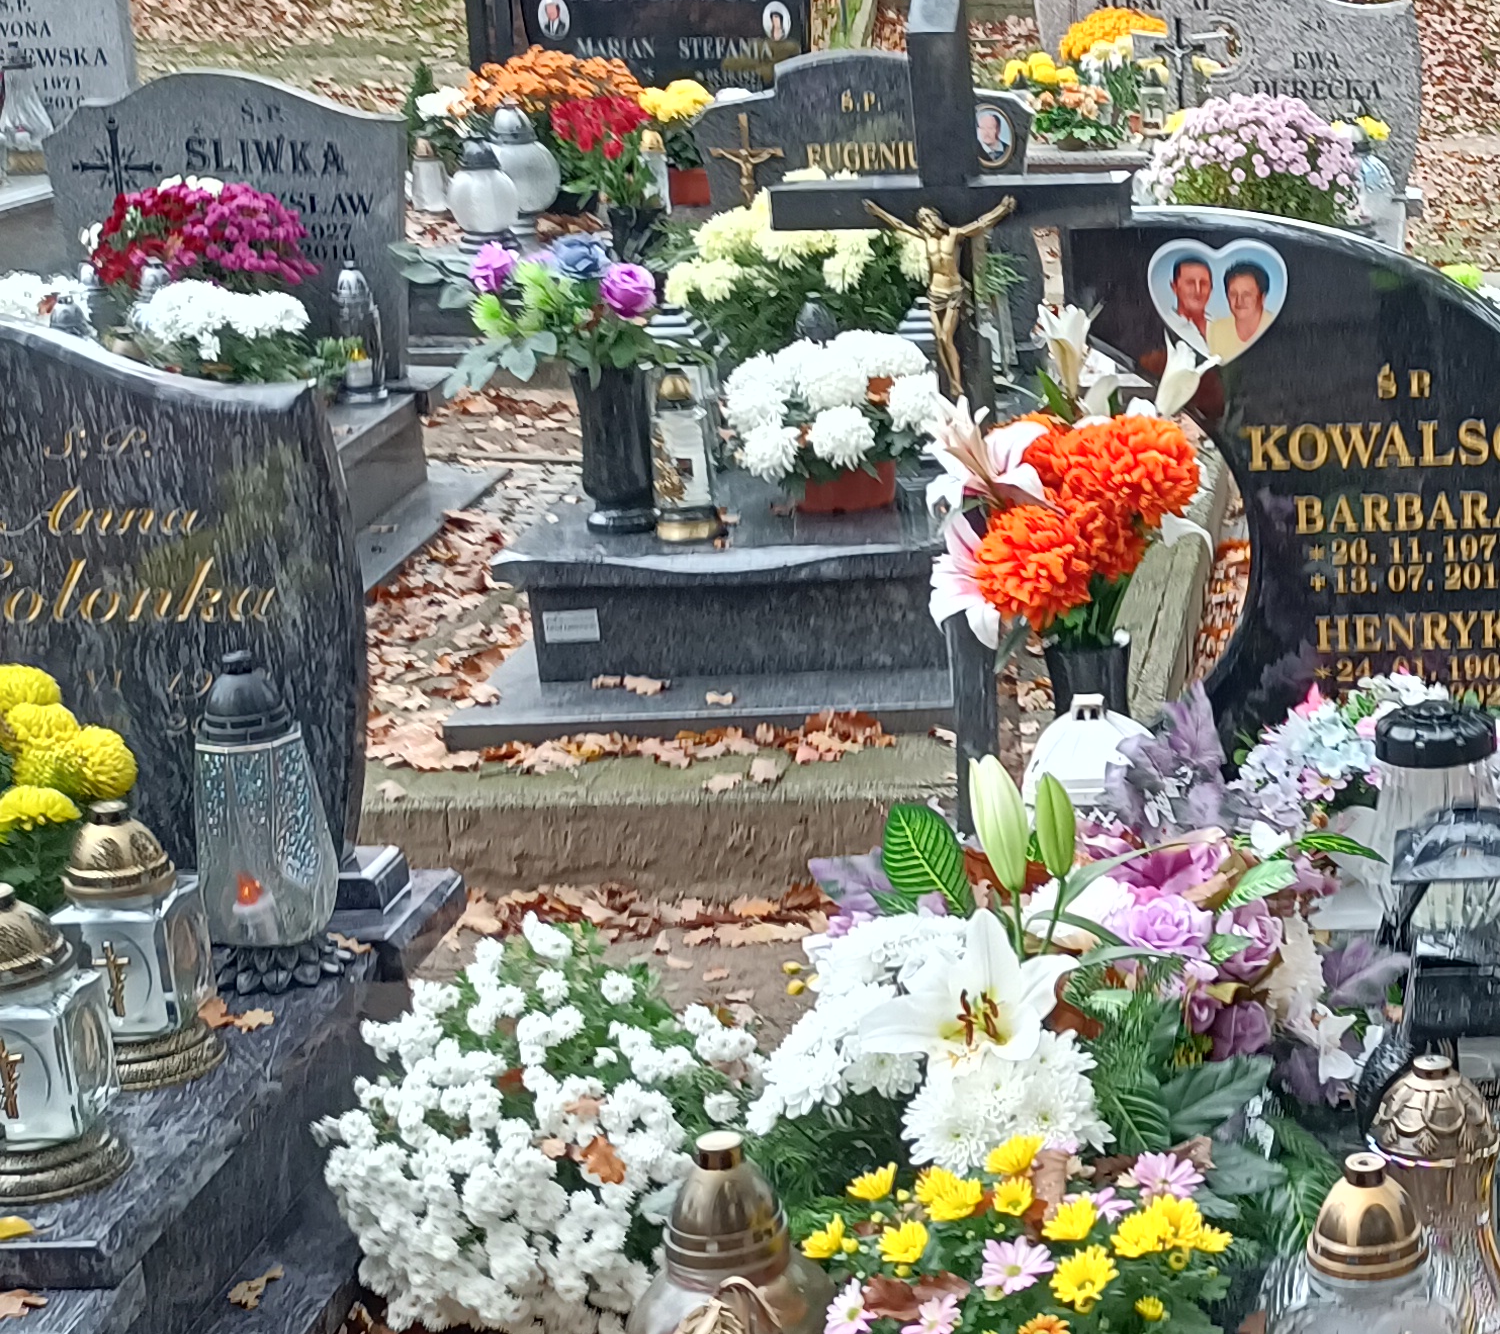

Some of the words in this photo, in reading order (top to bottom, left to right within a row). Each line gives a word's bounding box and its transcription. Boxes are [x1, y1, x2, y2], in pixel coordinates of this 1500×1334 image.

[678, 36, 774, 61] STEFANIA
[1293, 50, 1340, 70] EWA
[185, 120, 348, 176] ŚLIWKA
[0, 483, 207, 536] Anna
[0, 555, 276, 623] olonka
